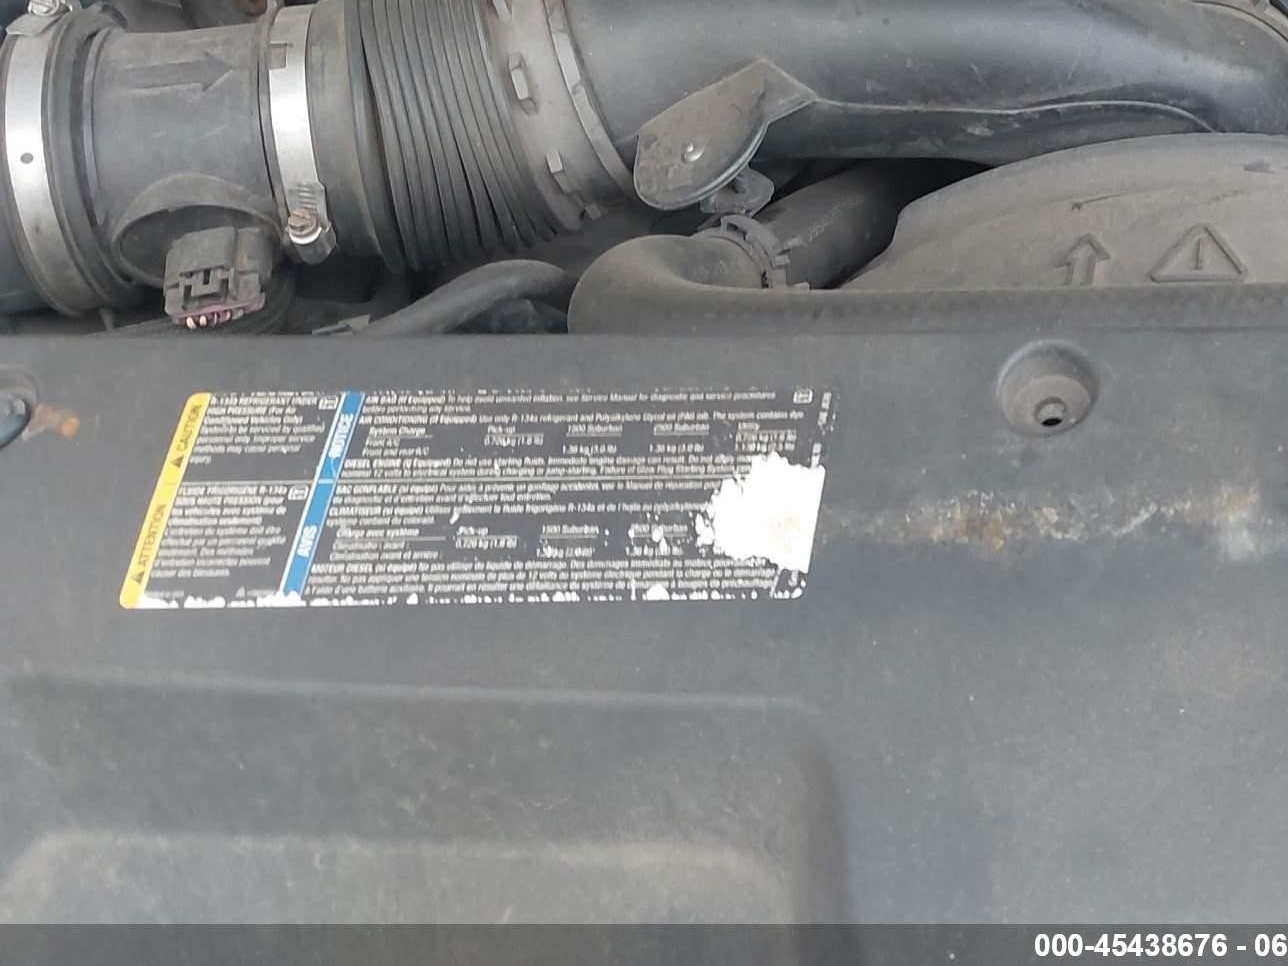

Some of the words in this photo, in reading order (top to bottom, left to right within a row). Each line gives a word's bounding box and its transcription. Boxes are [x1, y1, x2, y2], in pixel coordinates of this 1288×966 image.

[179, 404, 203, 454] CAUTION
[329, 413, 355, 458] NOTICE
[140, 504, 166, 568] ATTENTION
[297, 525, 317, 557] AVIS
